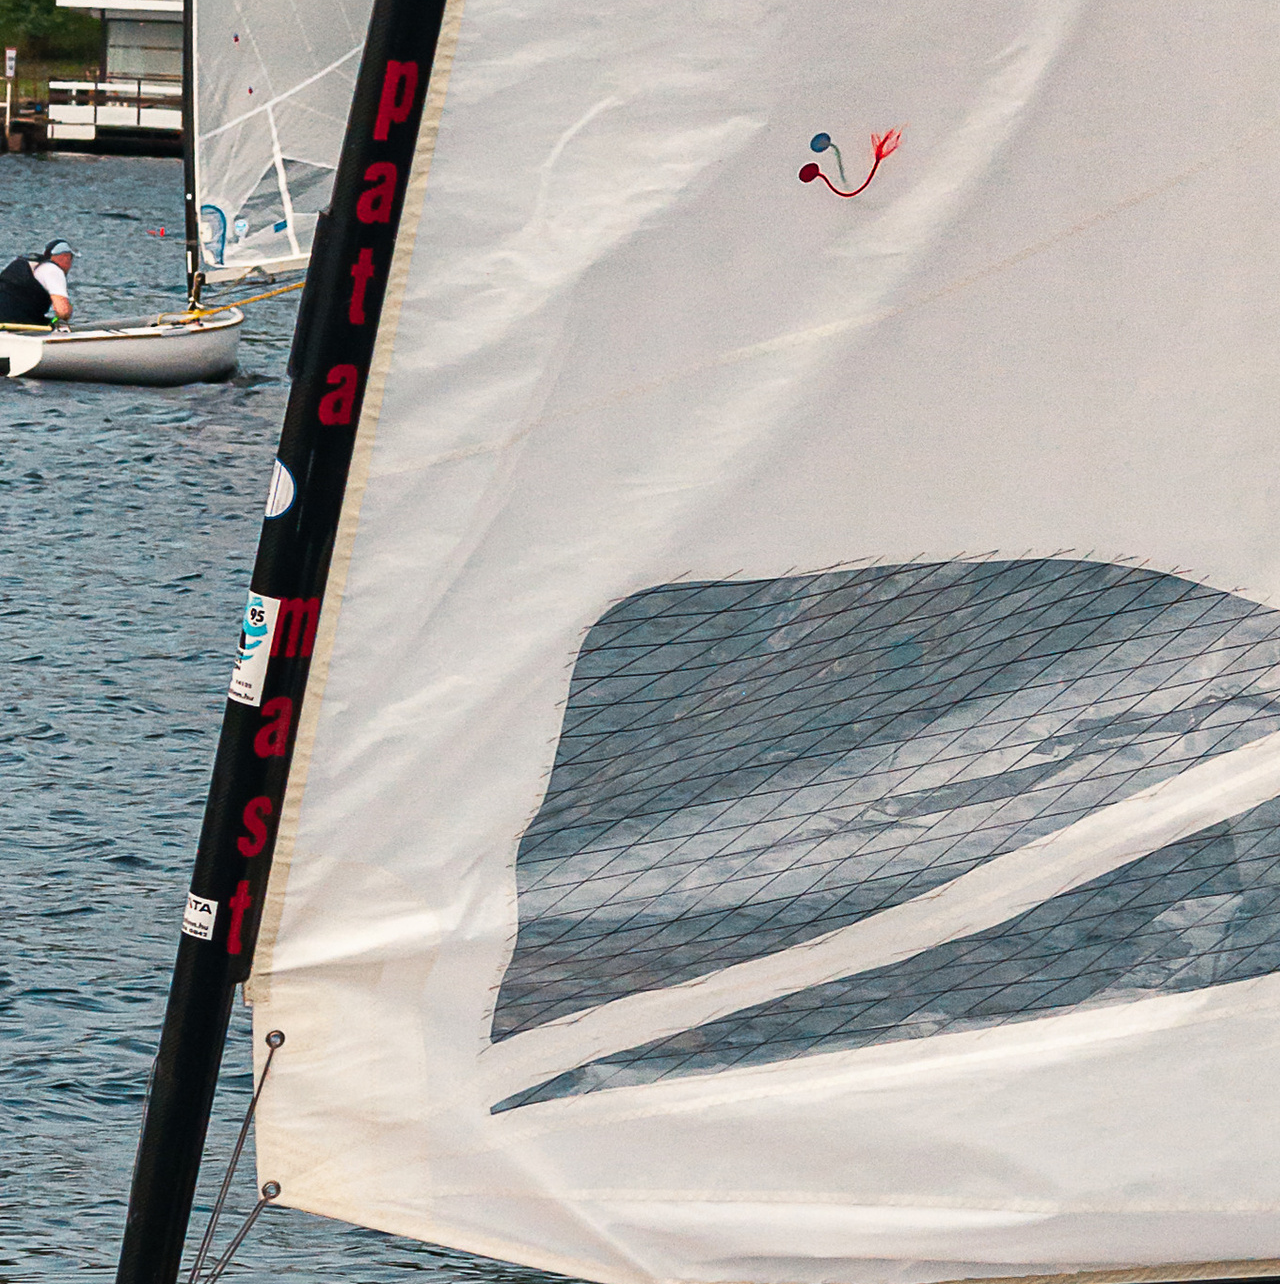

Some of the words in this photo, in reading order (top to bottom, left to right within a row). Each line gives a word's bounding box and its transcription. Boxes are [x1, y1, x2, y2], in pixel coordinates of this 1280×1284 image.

[318, 60, 419, 426] pata
[227, 596, 321, 956] mast
[250, 608, 265, 623] 95
